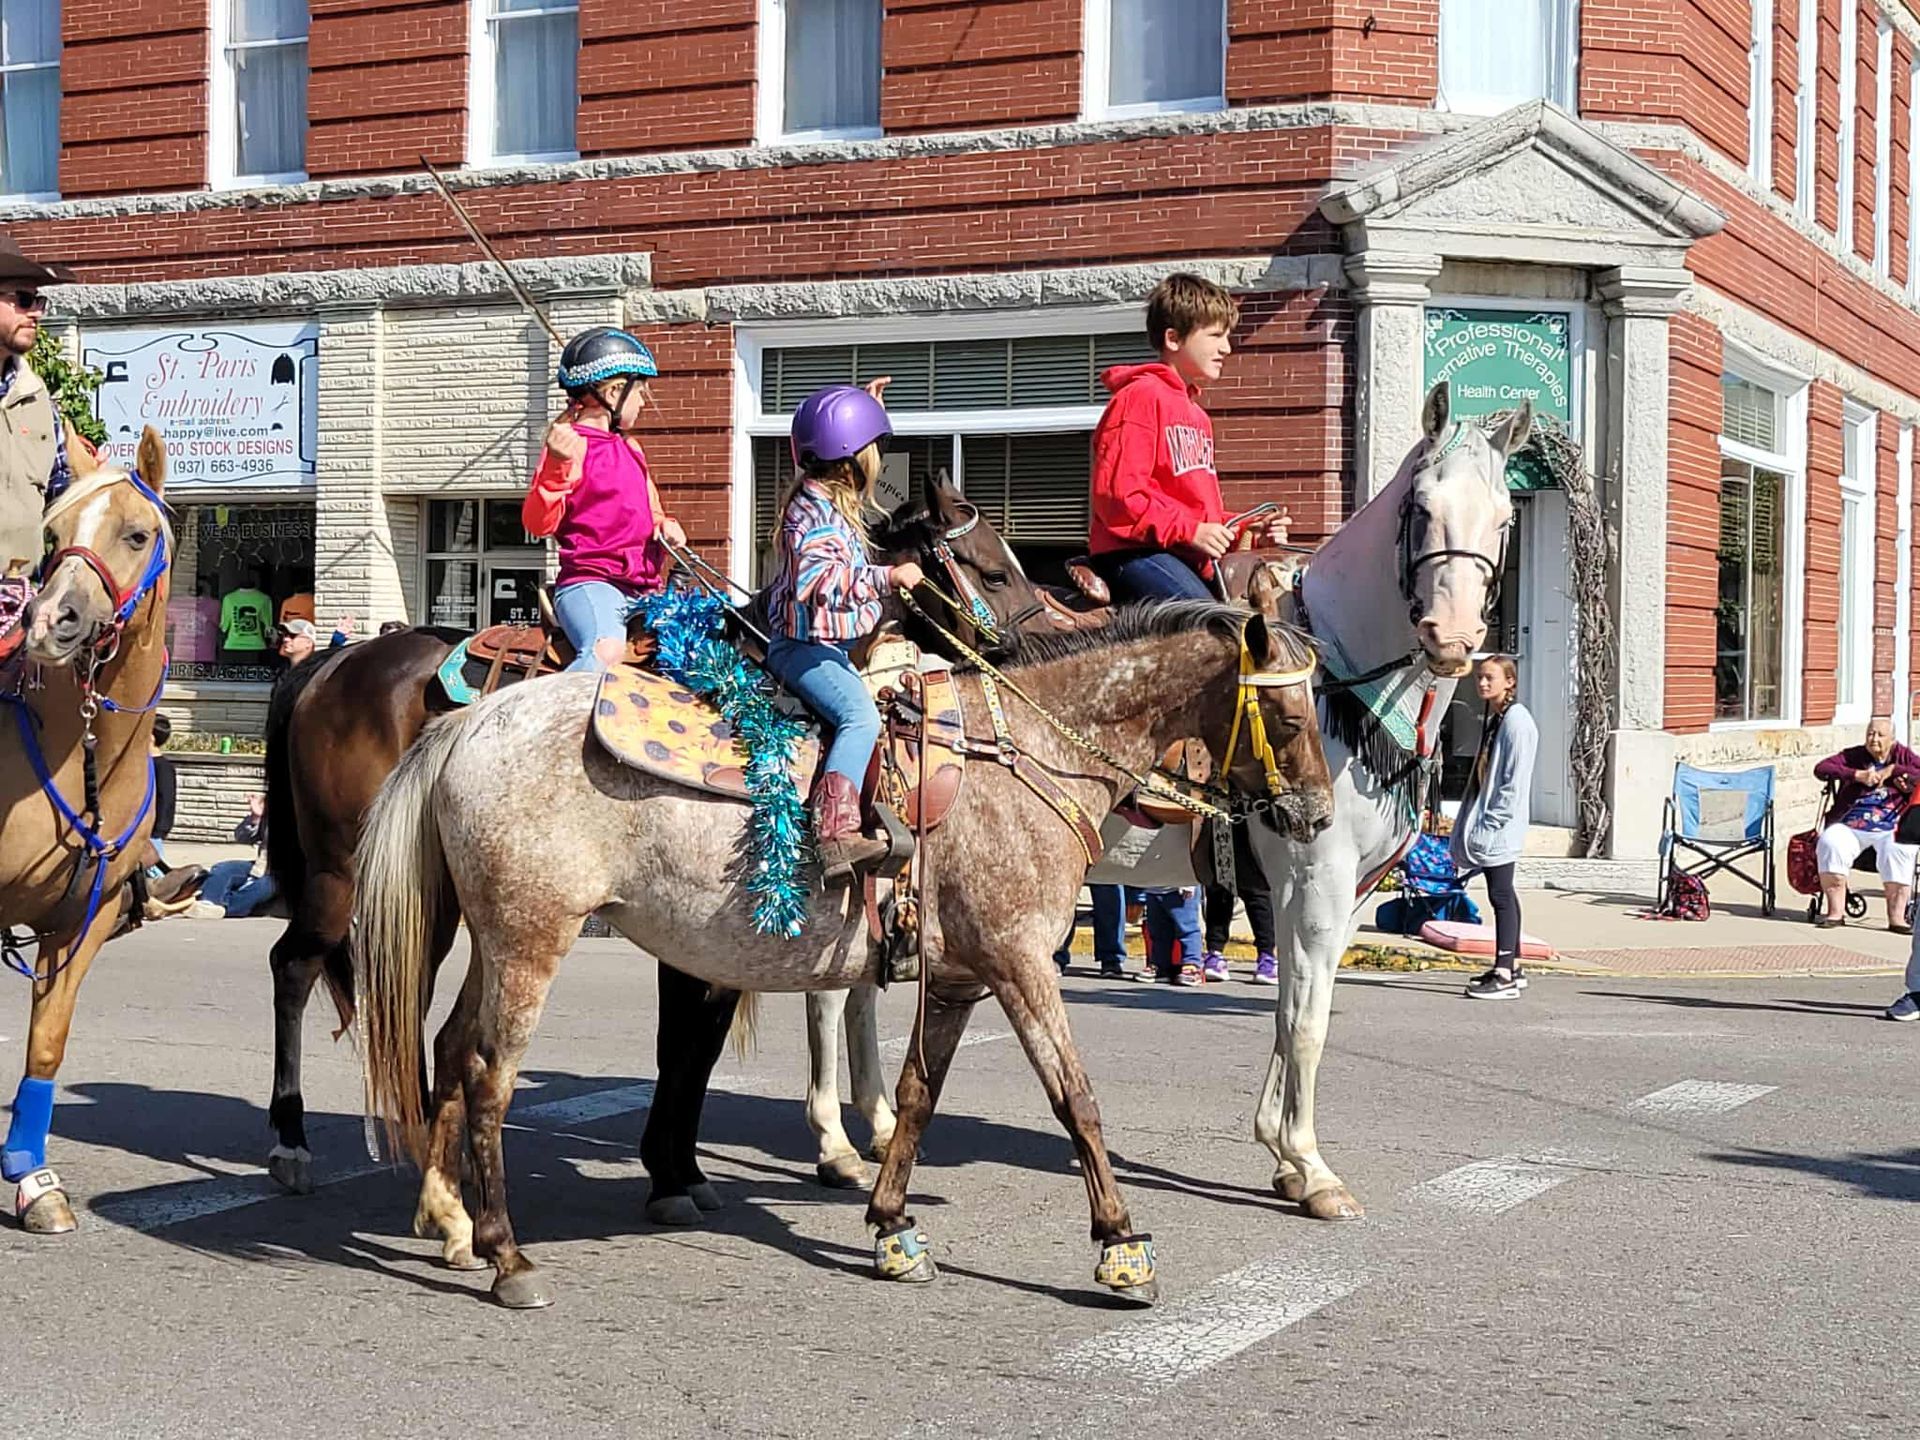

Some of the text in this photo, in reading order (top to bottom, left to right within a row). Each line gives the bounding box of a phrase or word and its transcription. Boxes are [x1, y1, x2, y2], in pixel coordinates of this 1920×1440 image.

[1435, 322, 1561, 361] Professional
[145, 350, 259, 390] St. Paris
[1503, 340, 1567, 408] Therapies
[1457, 384, 1540, 400] Health Center
[140, 387, 264, 421] Embroidery
[104, 442, 135, 458] OVER
[190, 440, 231, 456] STOCK
[237, 438, 293, 455] DESIGNS
[173, 459, 206, 475] (937)
[210, 459, 274, 473] 663-4936
[241, 521, 311, 540] BUSINESS
[509, 606, 528, 620] ST.
